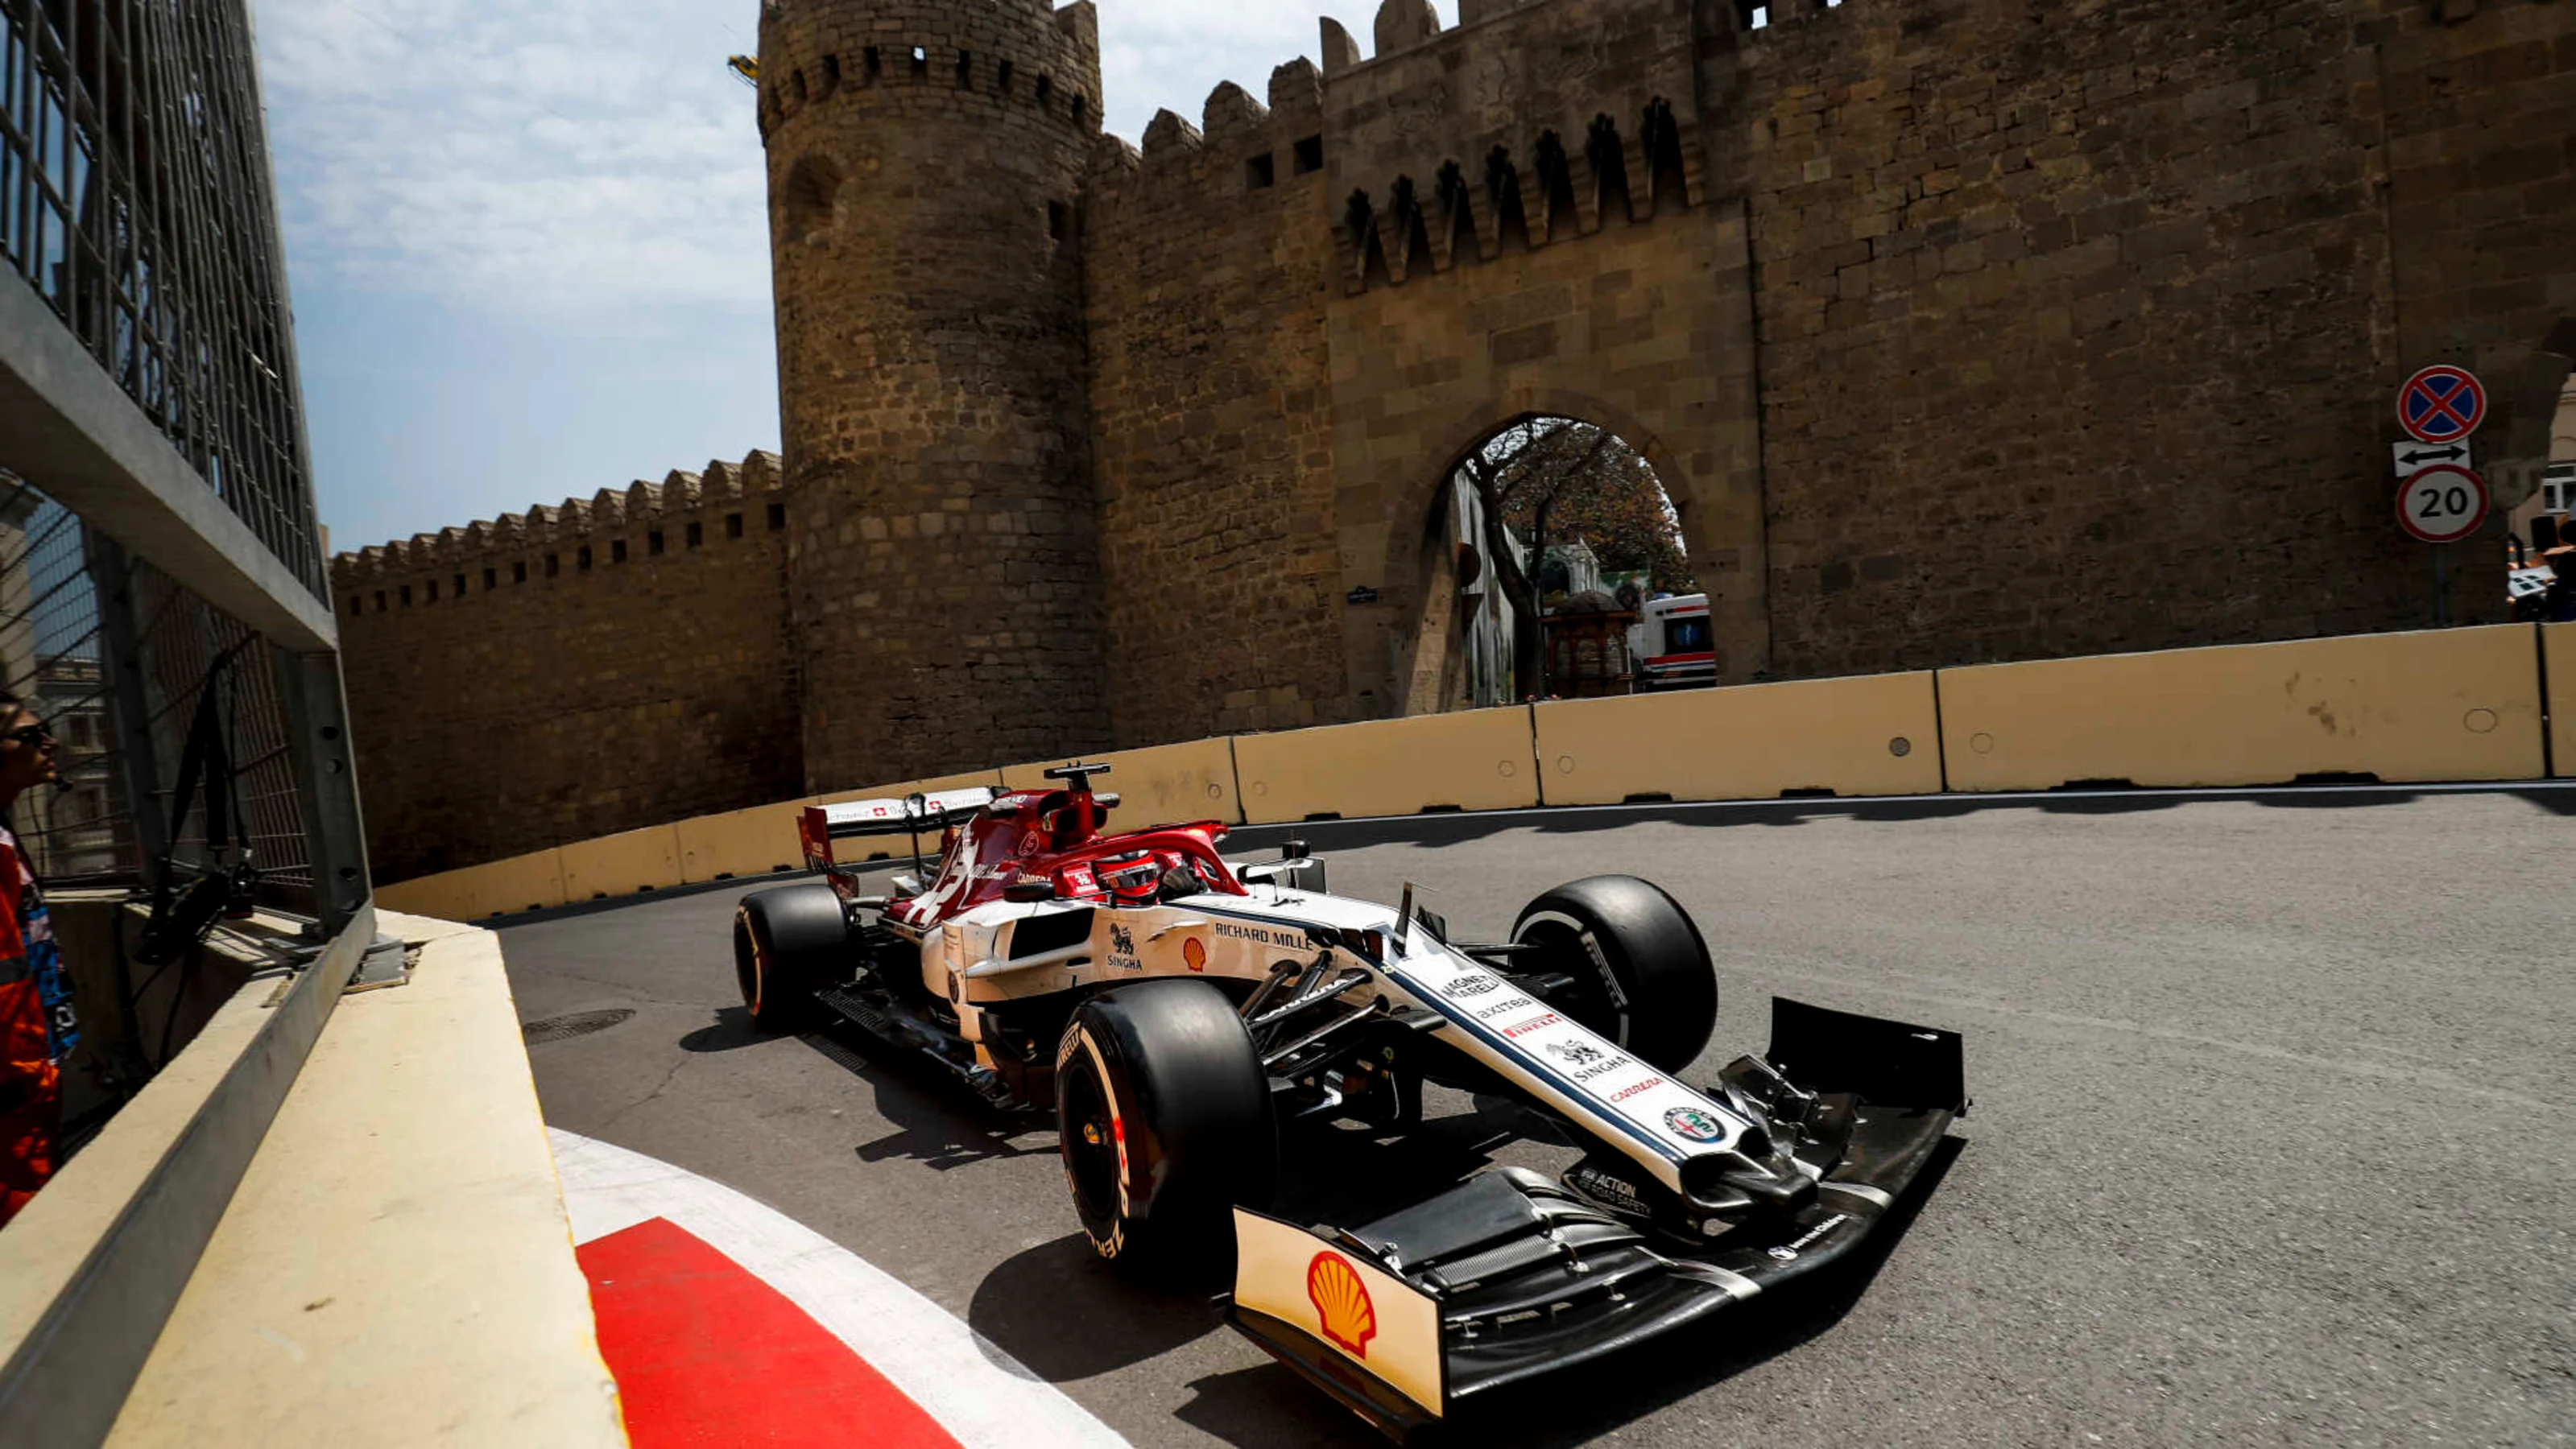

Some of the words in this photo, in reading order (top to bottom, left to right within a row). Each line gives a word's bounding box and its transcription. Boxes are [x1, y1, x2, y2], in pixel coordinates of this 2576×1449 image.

[2418, 485, 2469, 518] 20
[1215, 923, 1268, 943] RICHARD
[1273, 932, 1313, 951] MILLE
[1106, 954, 1143, 972] SINGHA
[1503, 1013, 1563, 1038] PIRELLI
[1573, 1055, 1632, 1083] SINGHA
[1610, 1076, 1664, 1104] CARRERA
[1595, 1174, 1637, 1199] ACTION
